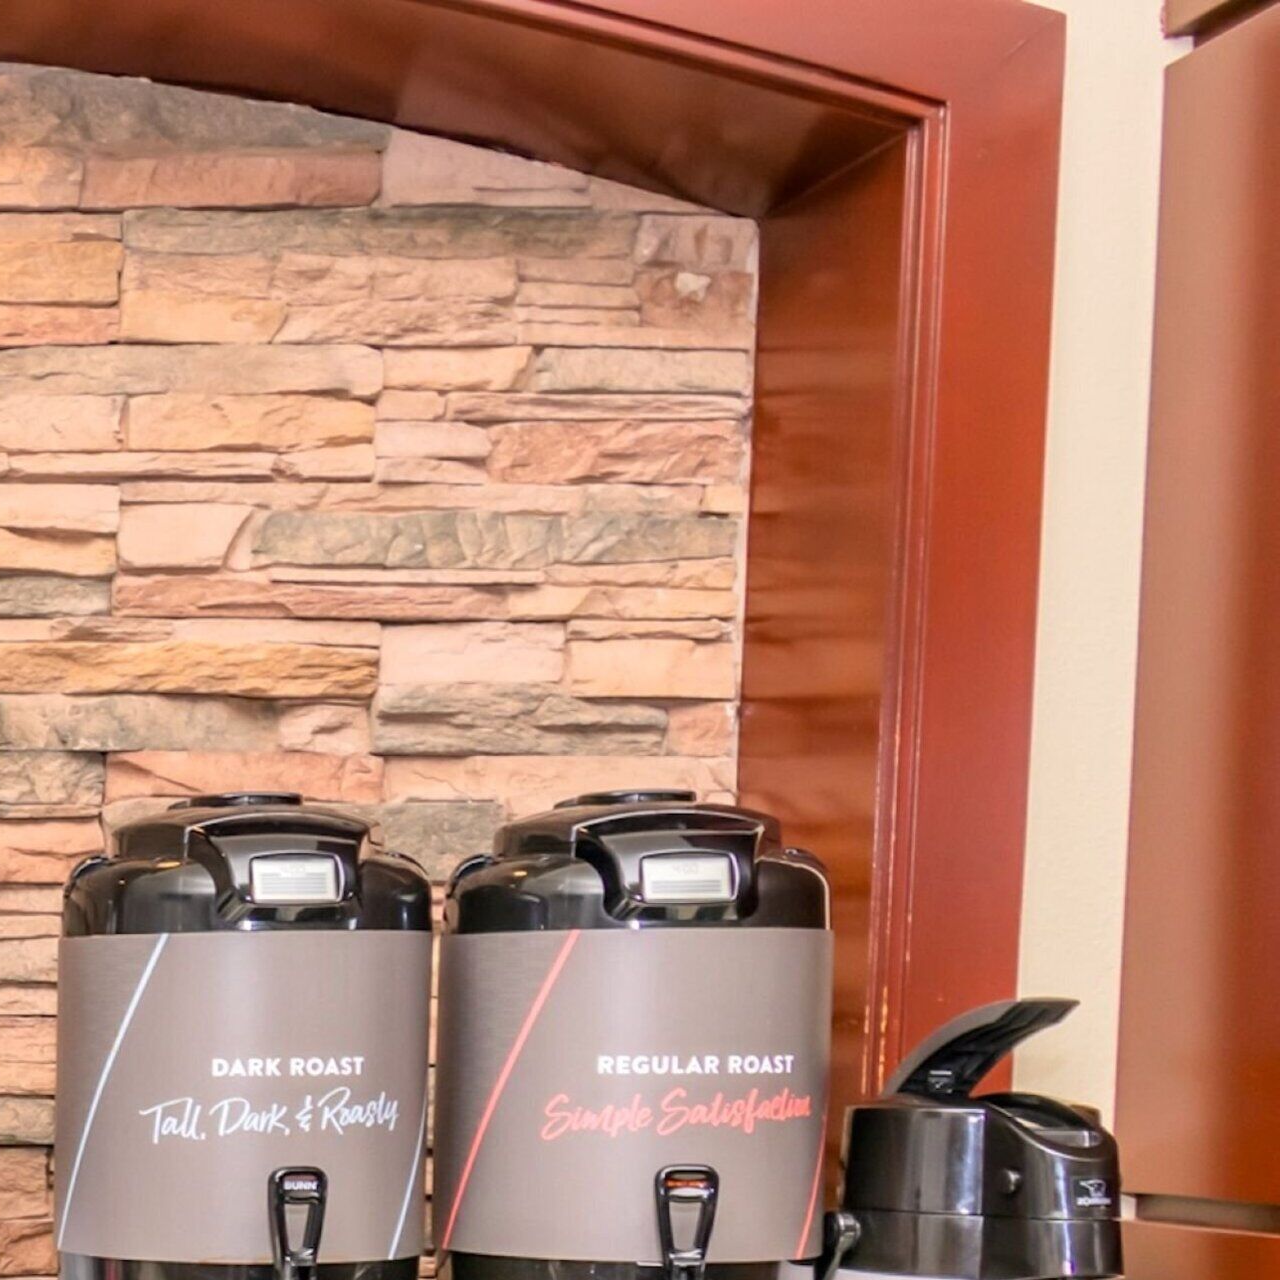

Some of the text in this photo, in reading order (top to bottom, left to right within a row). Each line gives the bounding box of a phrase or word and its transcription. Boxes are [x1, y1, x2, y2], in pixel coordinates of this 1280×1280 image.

[212, 1056, 365, 1077] DARK ROAST
[597, 1055, 794, 1074] REGULAR ROAST
[295, 1095, 313, 1132] &
[317, 1086, 400, 1135] Roasty
[541, 1087, 811, 1140] Simple Satisfaction
[283, 1180, 319, 1191] BUNN
